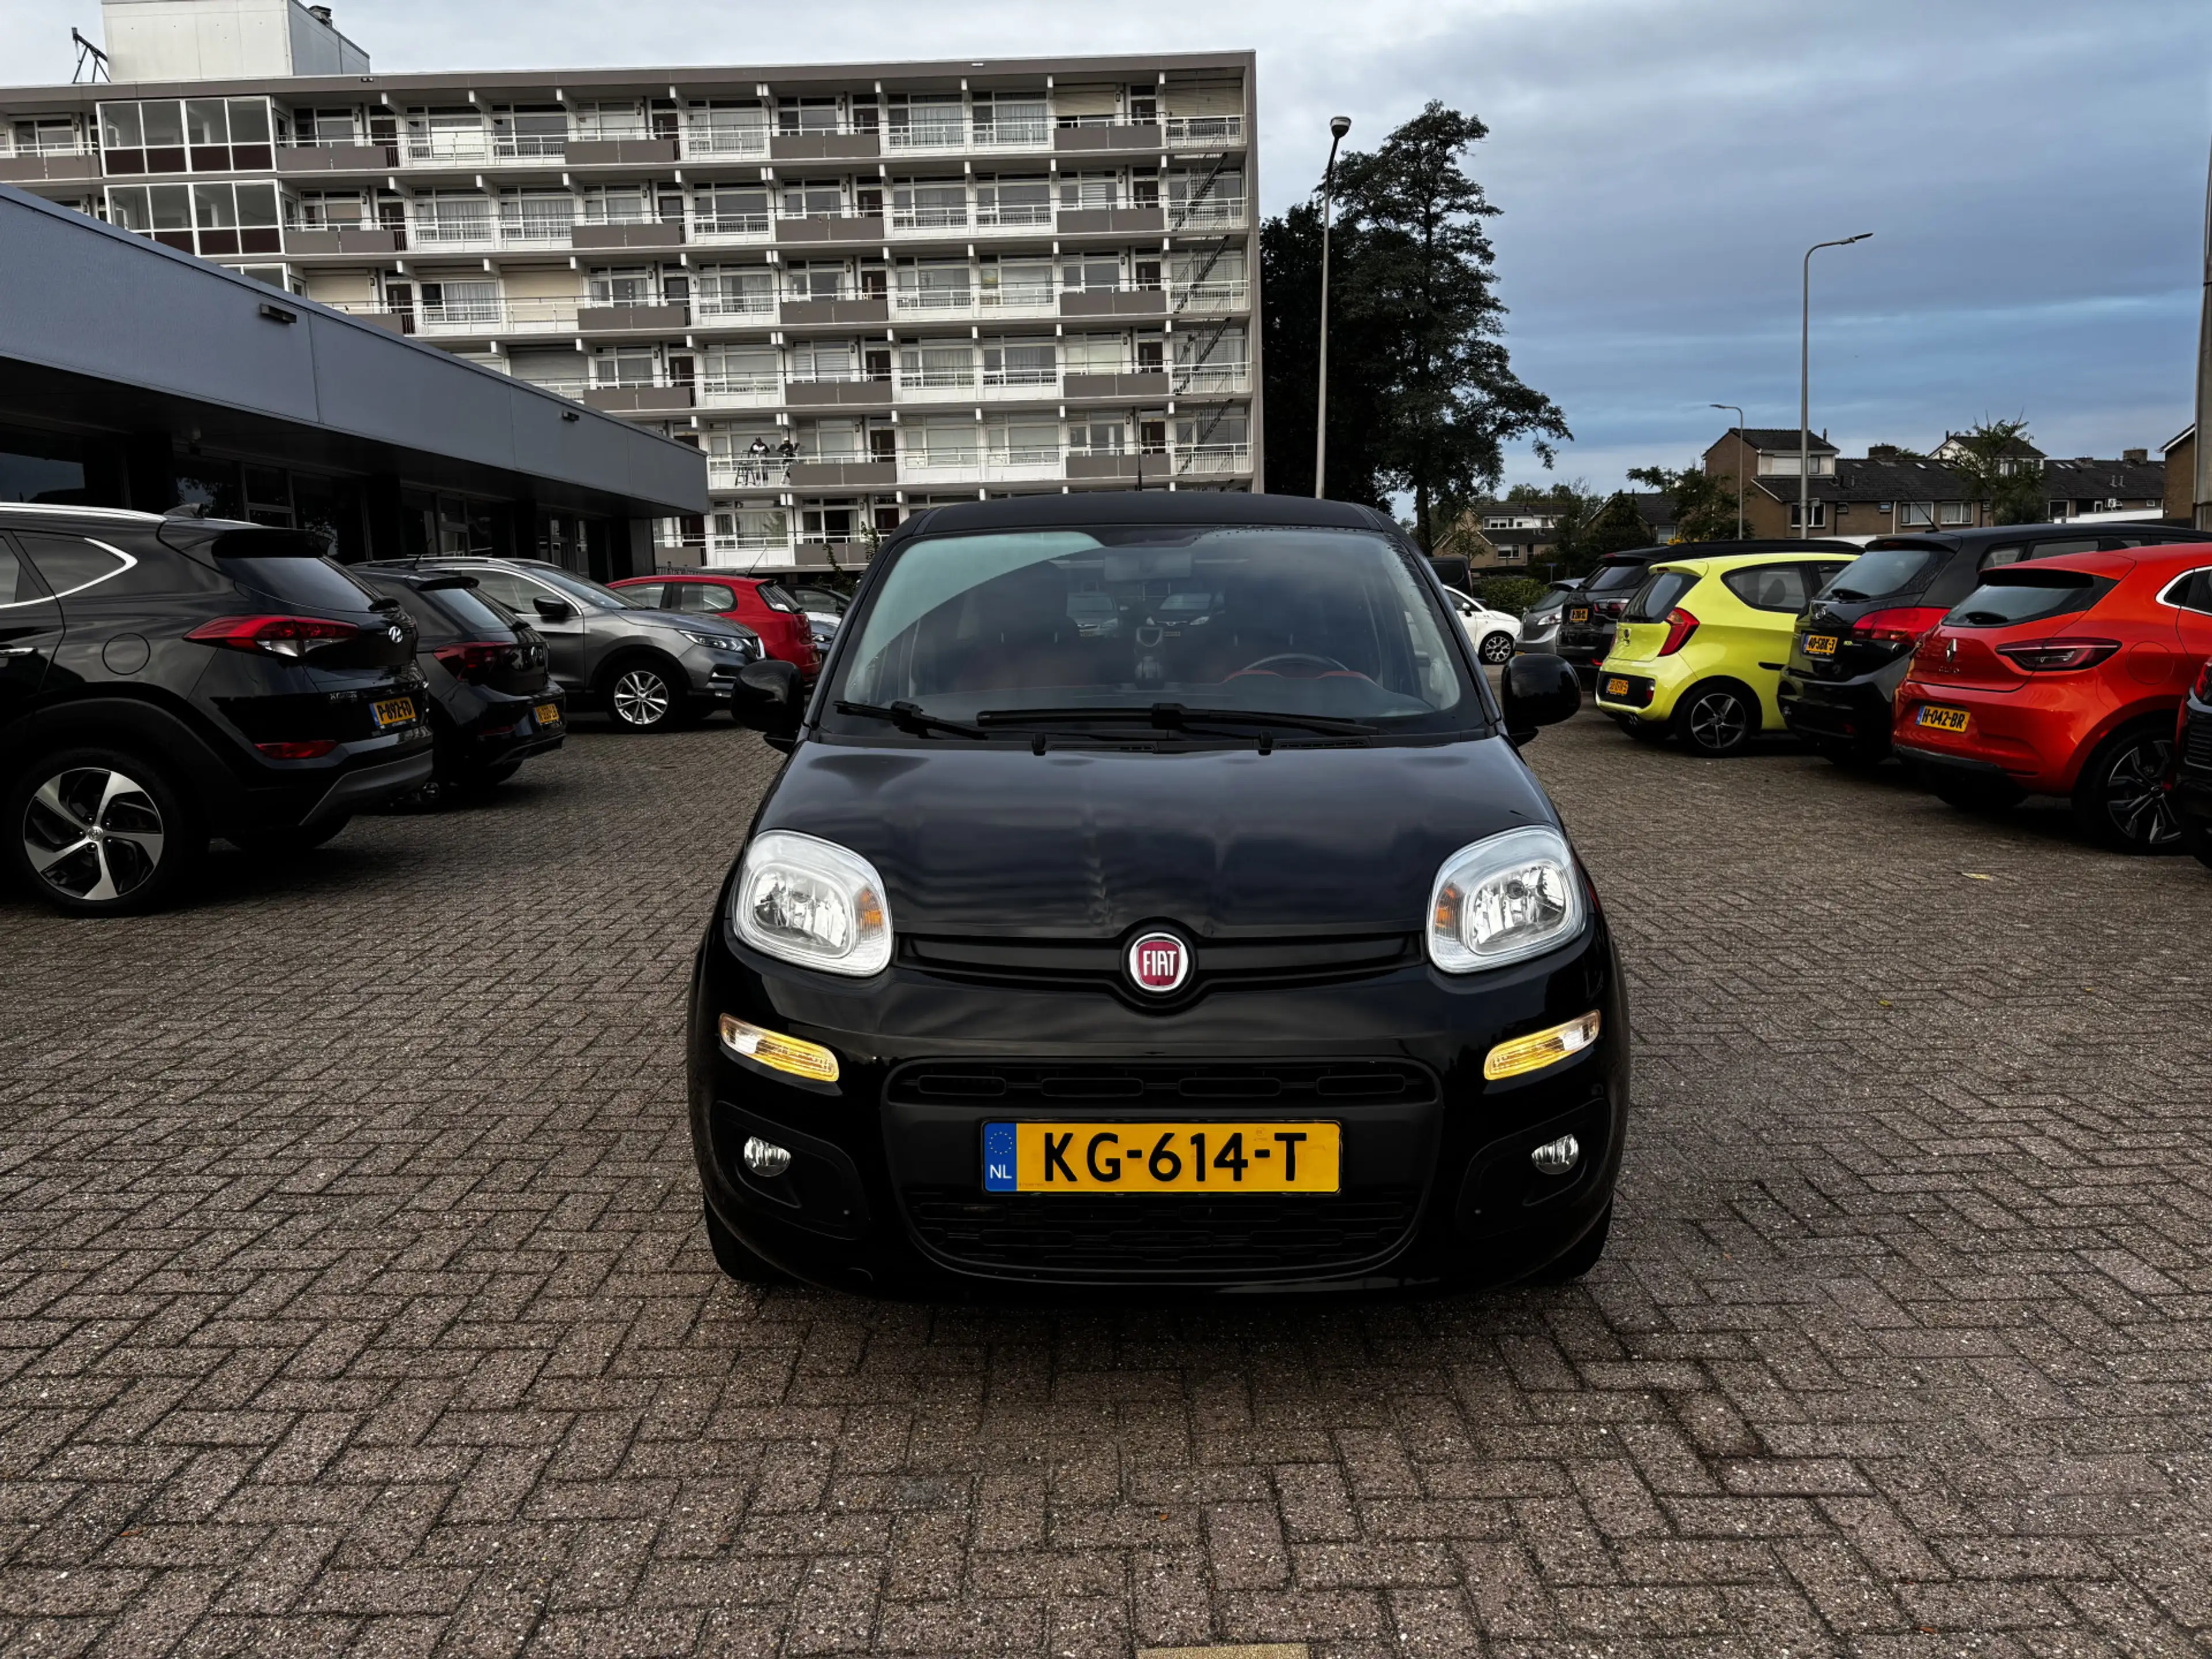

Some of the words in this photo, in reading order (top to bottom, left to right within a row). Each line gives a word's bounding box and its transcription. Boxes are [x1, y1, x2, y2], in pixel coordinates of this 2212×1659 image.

[1922, 709, 1965, 729] H-042-BR
[1143, 950, 1177, 976] FIAT
[989, 1164, 1013, 1179] NL
[1044, 1132, 1307, 1182] KG-614-T
